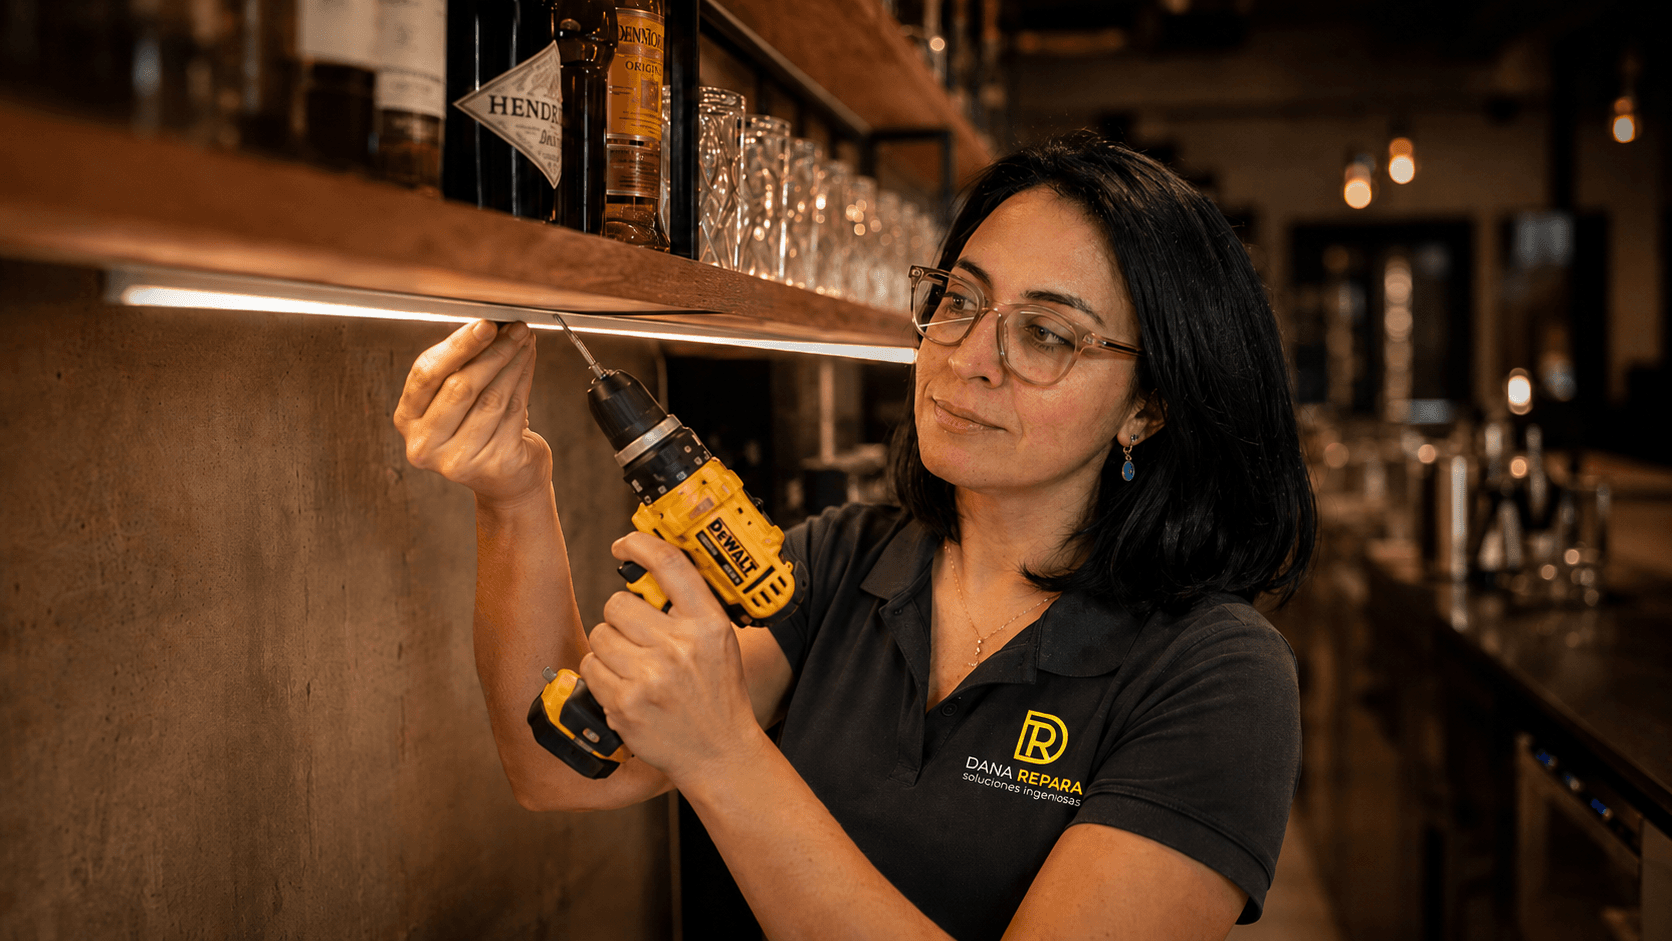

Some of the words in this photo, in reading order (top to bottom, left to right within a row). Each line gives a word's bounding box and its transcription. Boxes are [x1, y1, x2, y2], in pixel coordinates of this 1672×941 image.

[962, 772, 1021, 793] soluciones
[1023, 786, 1081, 807] ingeniosas
[965, 756, 1013, 780] DANA
[1017, 769, 1083, 795] REPARA
